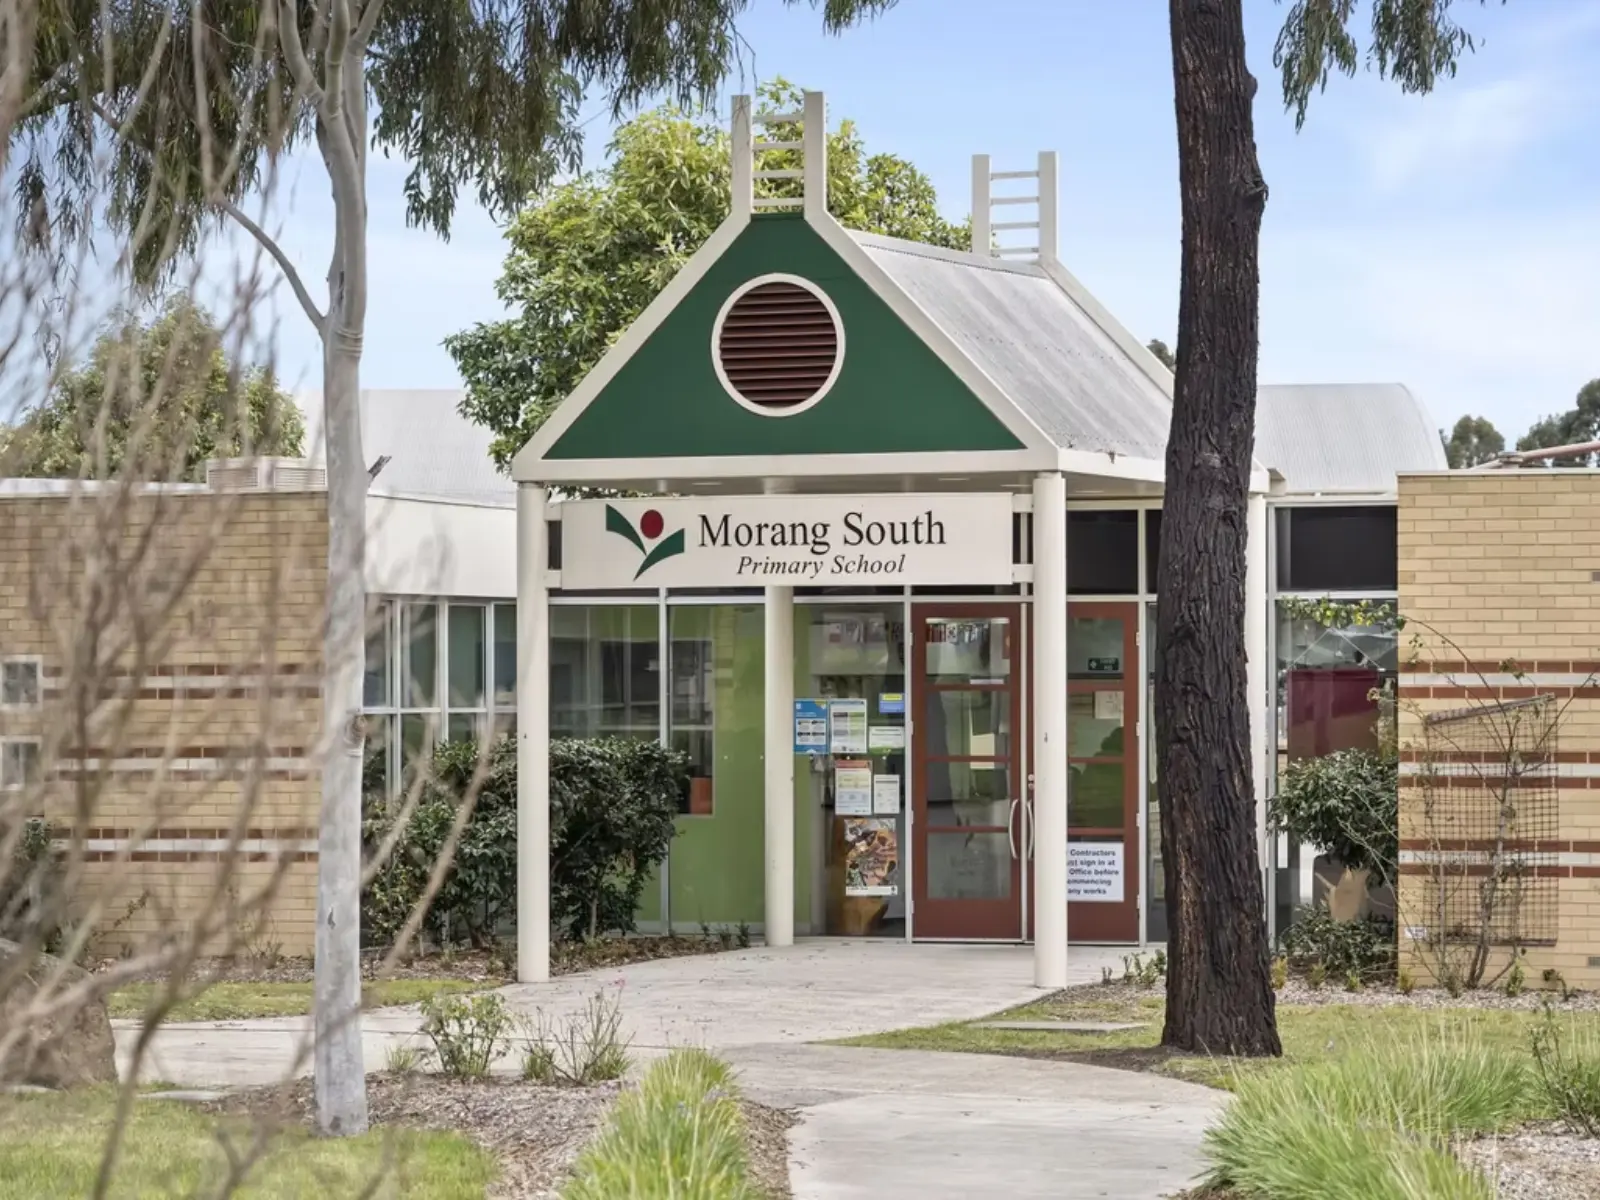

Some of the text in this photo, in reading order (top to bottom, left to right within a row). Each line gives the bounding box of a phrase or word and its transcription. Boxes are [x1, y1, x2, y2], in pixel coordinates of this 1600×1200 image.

[697, 510, 947, 555] Morang South
[736, 553, 906, 579] Primary School
[1070, 848, 1116, 856] Contractors
[1080, 859, 1096, 867] sign
[1068, 868, 1092, 876] Office
